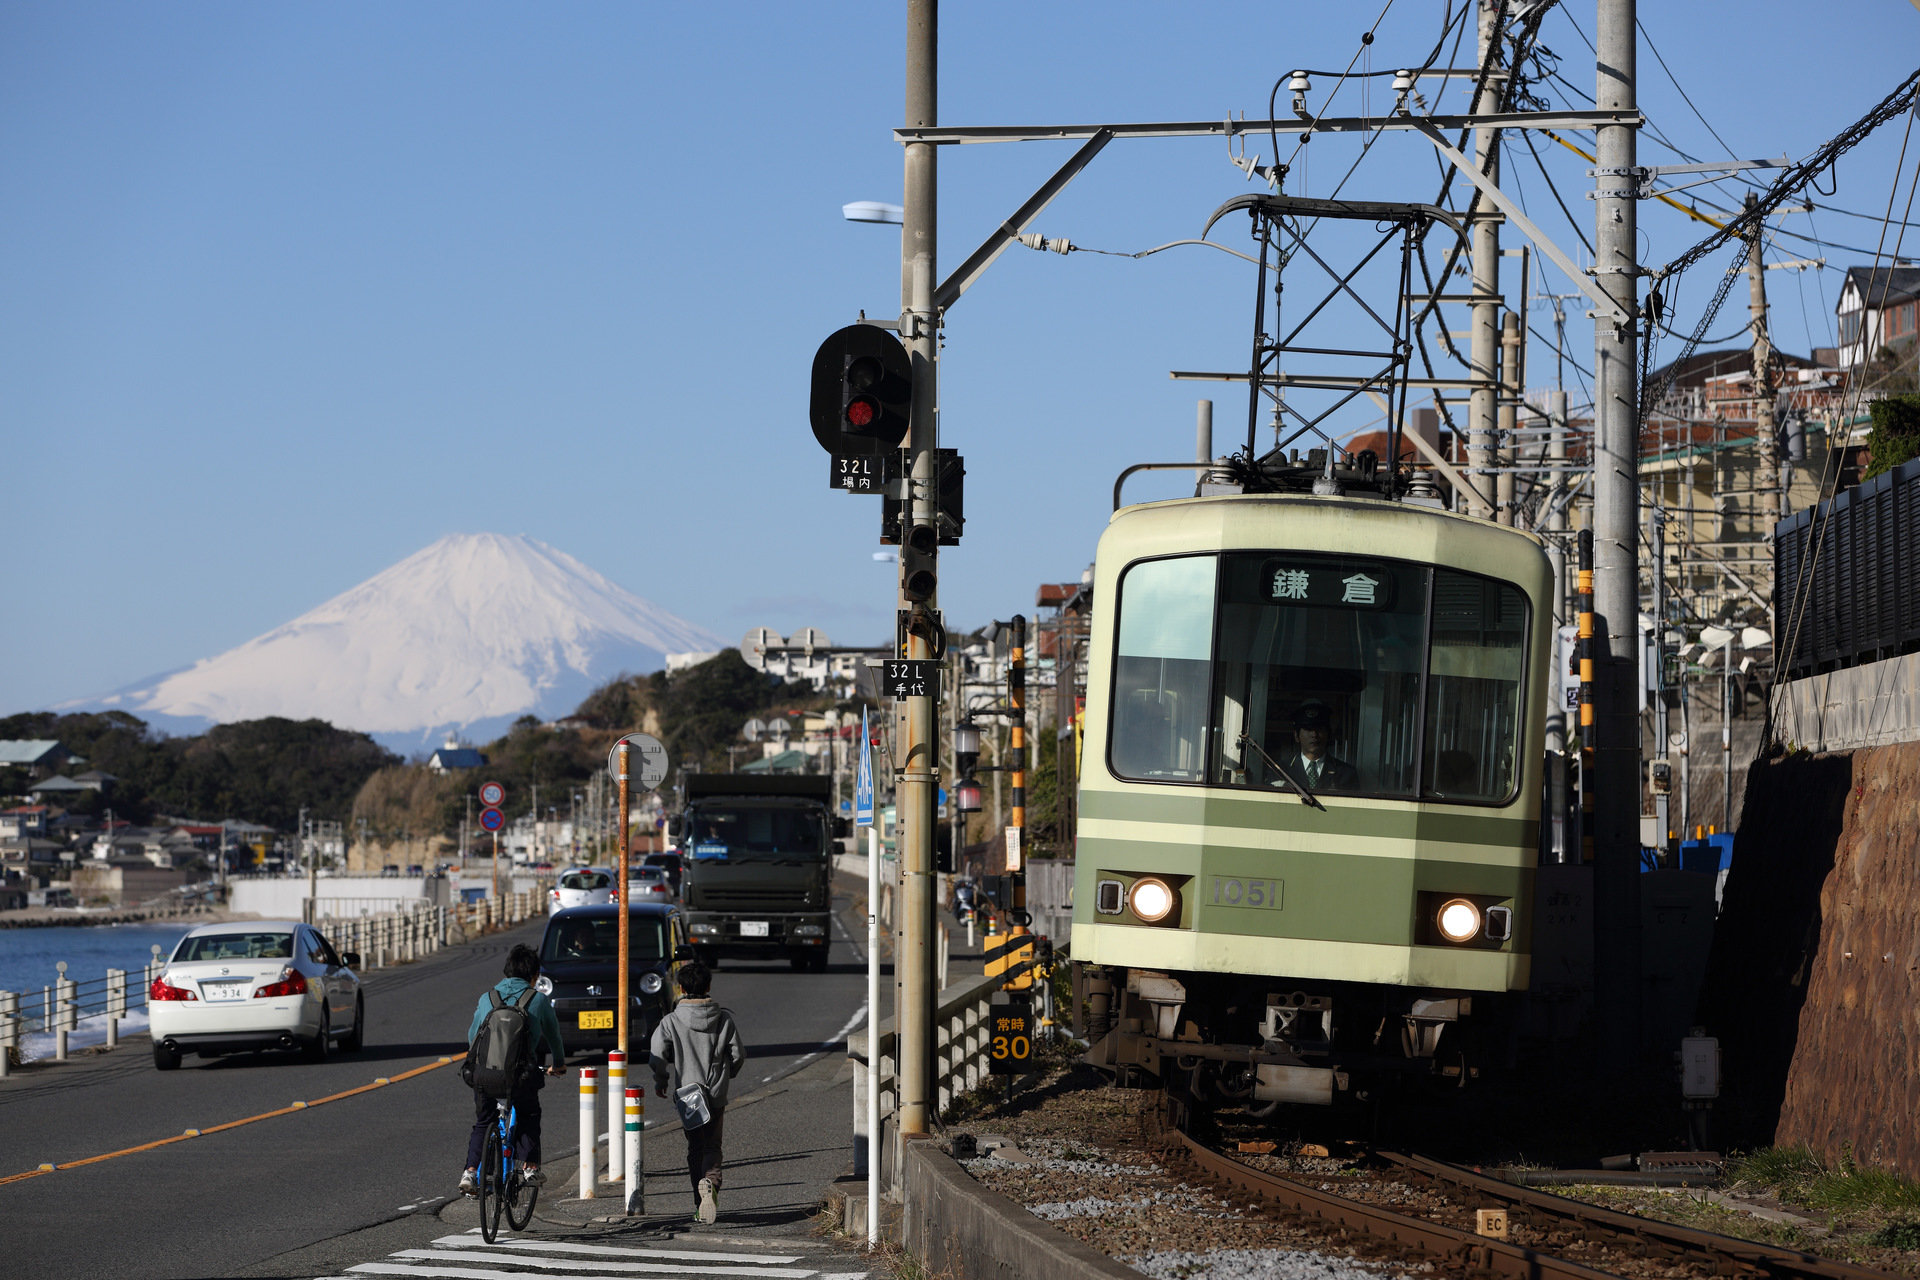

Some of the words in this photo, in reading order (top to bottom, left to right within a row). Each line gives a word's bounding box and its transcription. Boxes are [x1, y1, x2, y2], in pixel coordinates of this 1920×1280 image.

[842, 476, 870, 489] 場内
[895, 681, 925, 696] 手代
[485, 788, 500, 800] 50
[1214, 878, 1276, 907] 1051
[996, 1017, 1025, 1031] 常時
[991, 1035, 1030, 1060] 30
[1486, 1217, 1502, 1231] EC
